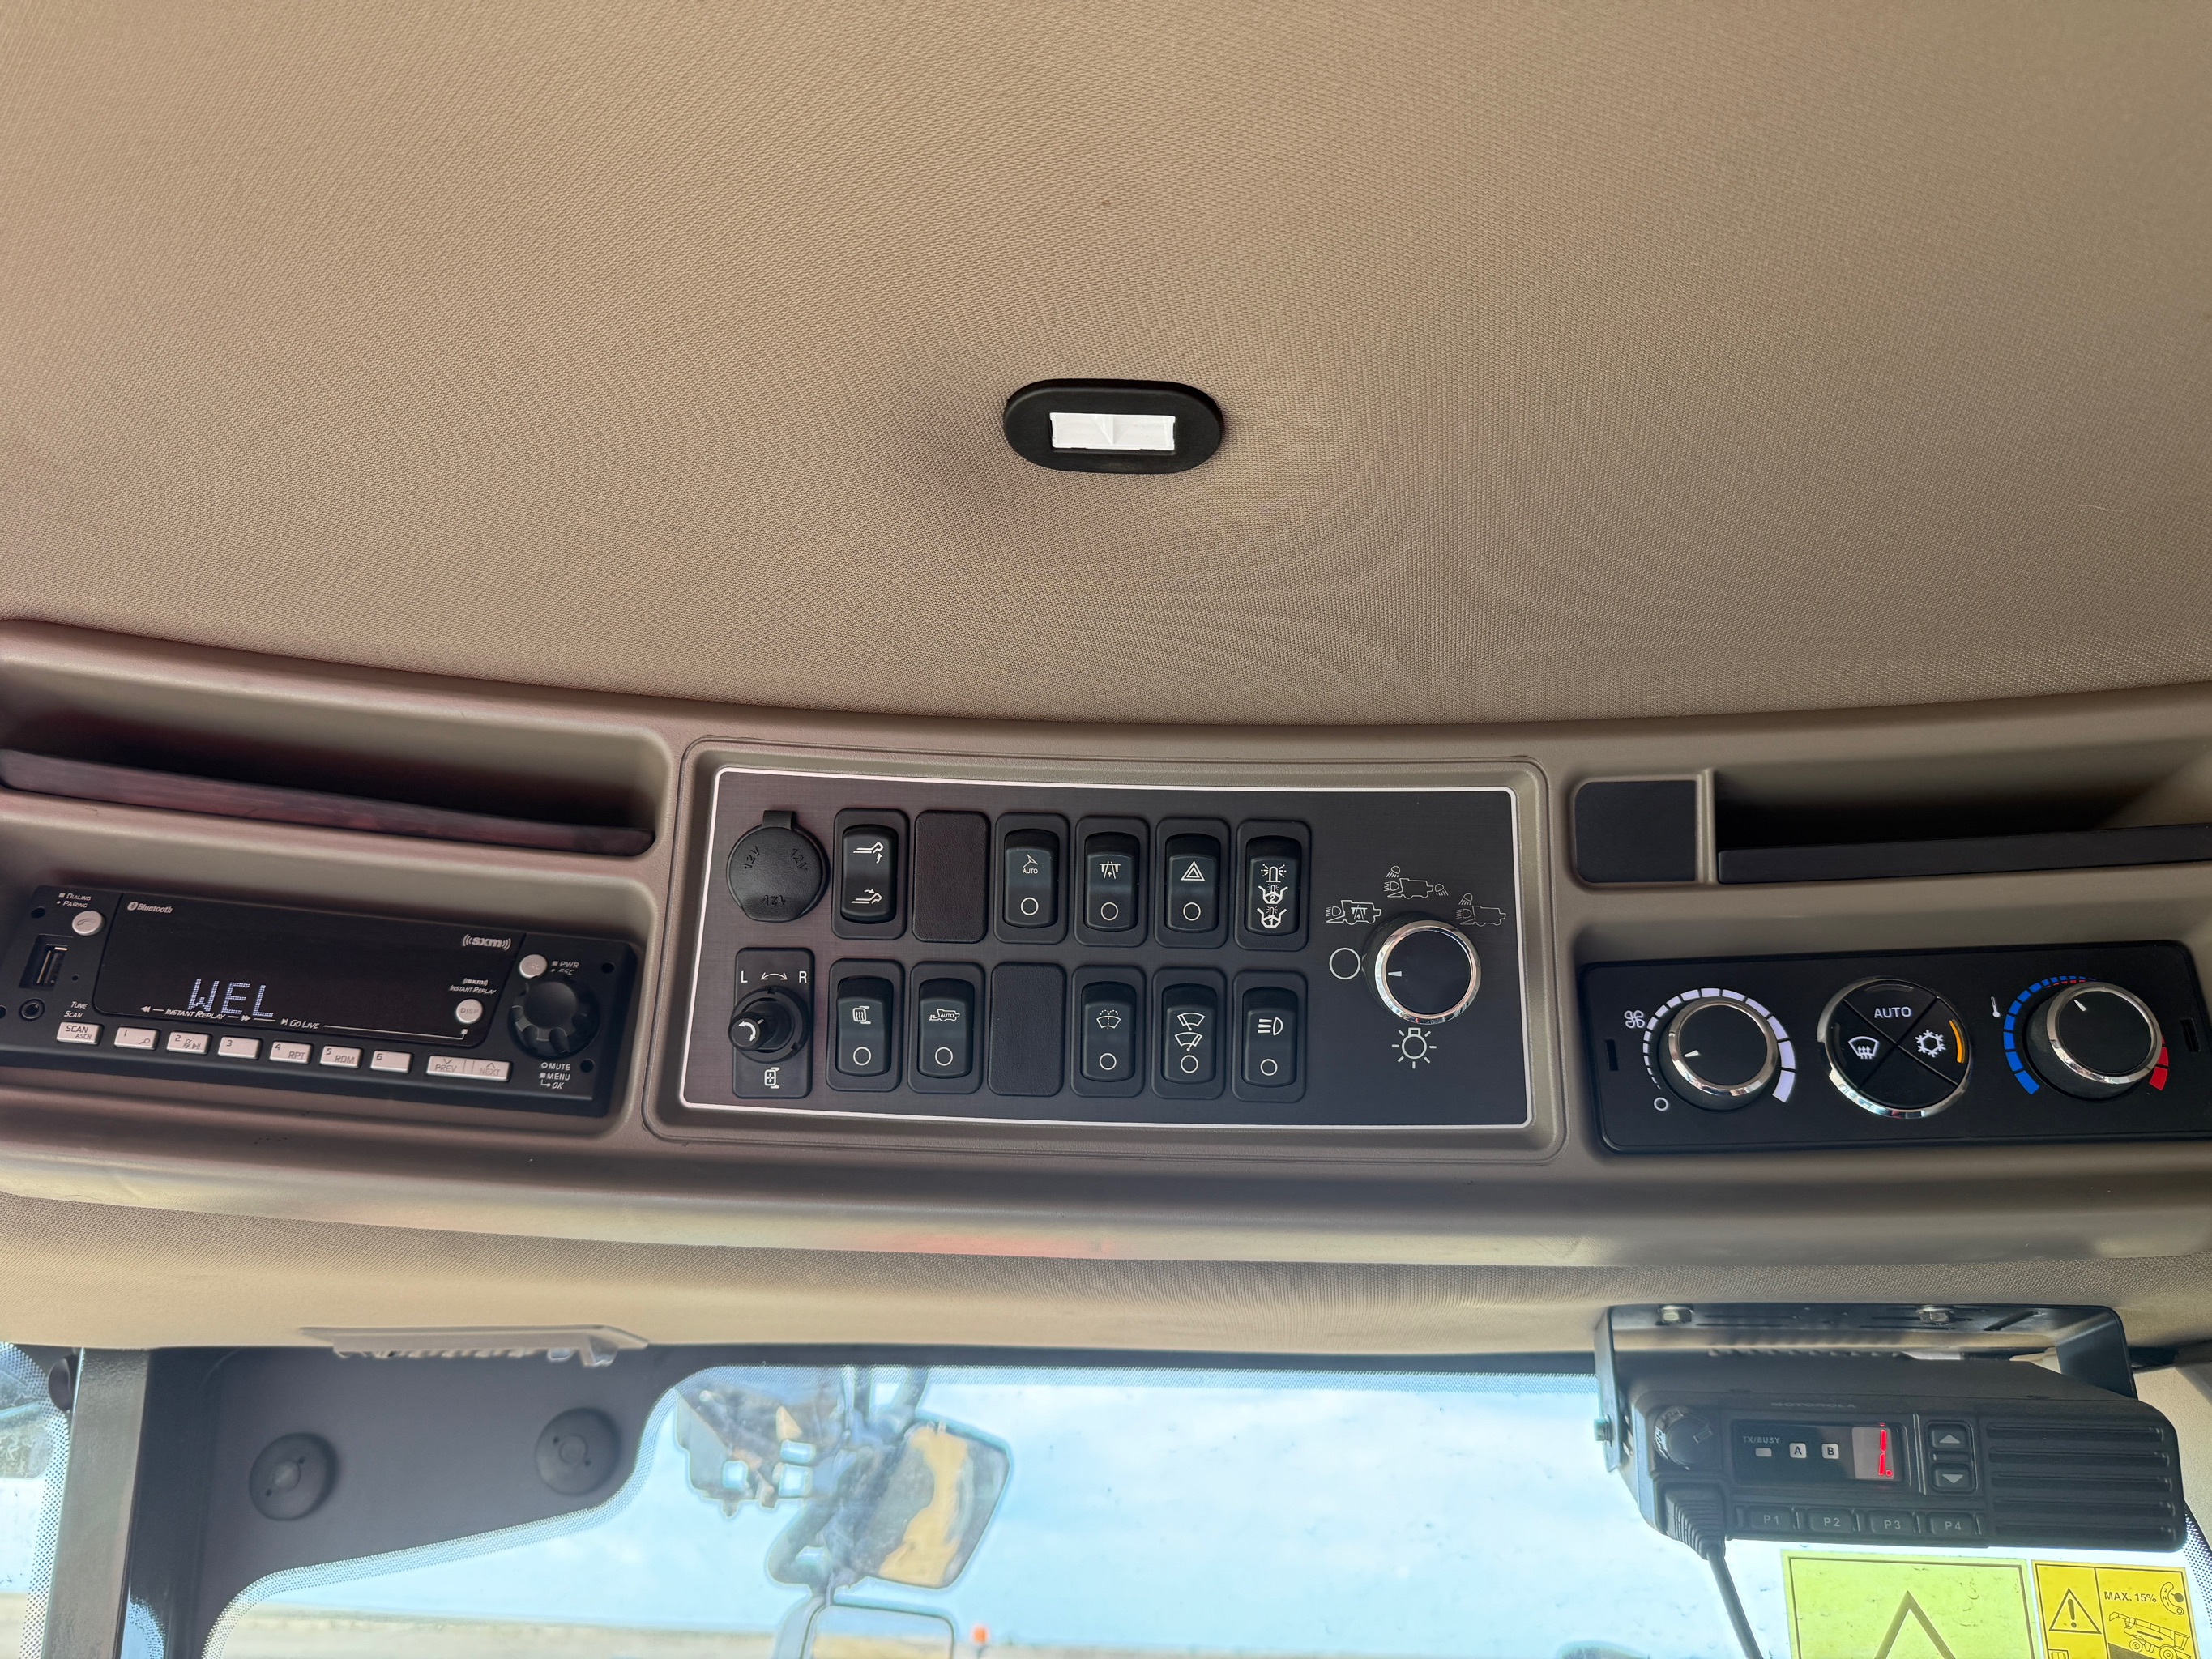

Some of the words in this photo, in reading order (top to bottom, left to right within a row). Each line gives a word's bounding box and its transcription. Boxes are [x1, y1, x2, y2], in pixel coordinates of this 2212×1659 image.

[136, 903, 173, 914] Bluetooth
[472, 936, 503, 948] sxm
[741, 970, 748, 983] L
[799, 970, 807, 983] R
[187, 979, 274, 1017] WEL
[164, 1008, 196, 1017] INSTANT
[194, 1011, 227, 1021] REPLAY
[1873, 1006, 1912, 1018] AUTO
[66, 1025, 89, 1034] SCAN
[288, 1051, 306, 1060] RPT
[326, 1047, 332, 1056] 5
[335, 1055, 355, 1064] RDM
[434, 1064, 457, 1073] PREV
[549, 1062, 571, 1071] MUTE
[479, 1068, 501, 1077] NEXT
[547, 1072, 570, 1081] MENU
[552, 1081, 565, 1090] OK
[1743, 1435, 1780, 1444] TX/BUSY
[1794, 1446, 1803, 1456] A
[1827, 1447, 1834, 1456] B
[1763, 1515, 1780, 1525] P1
[1824, 1517, 1841, 1528] P2
[1884, 1520, 1901, 1530] P3
[1945, 1521, 1962, 1531] P4
[2103, 1591, 2132, 1602] MAX.
[2134, 1593, 2157, 1604] 15%
